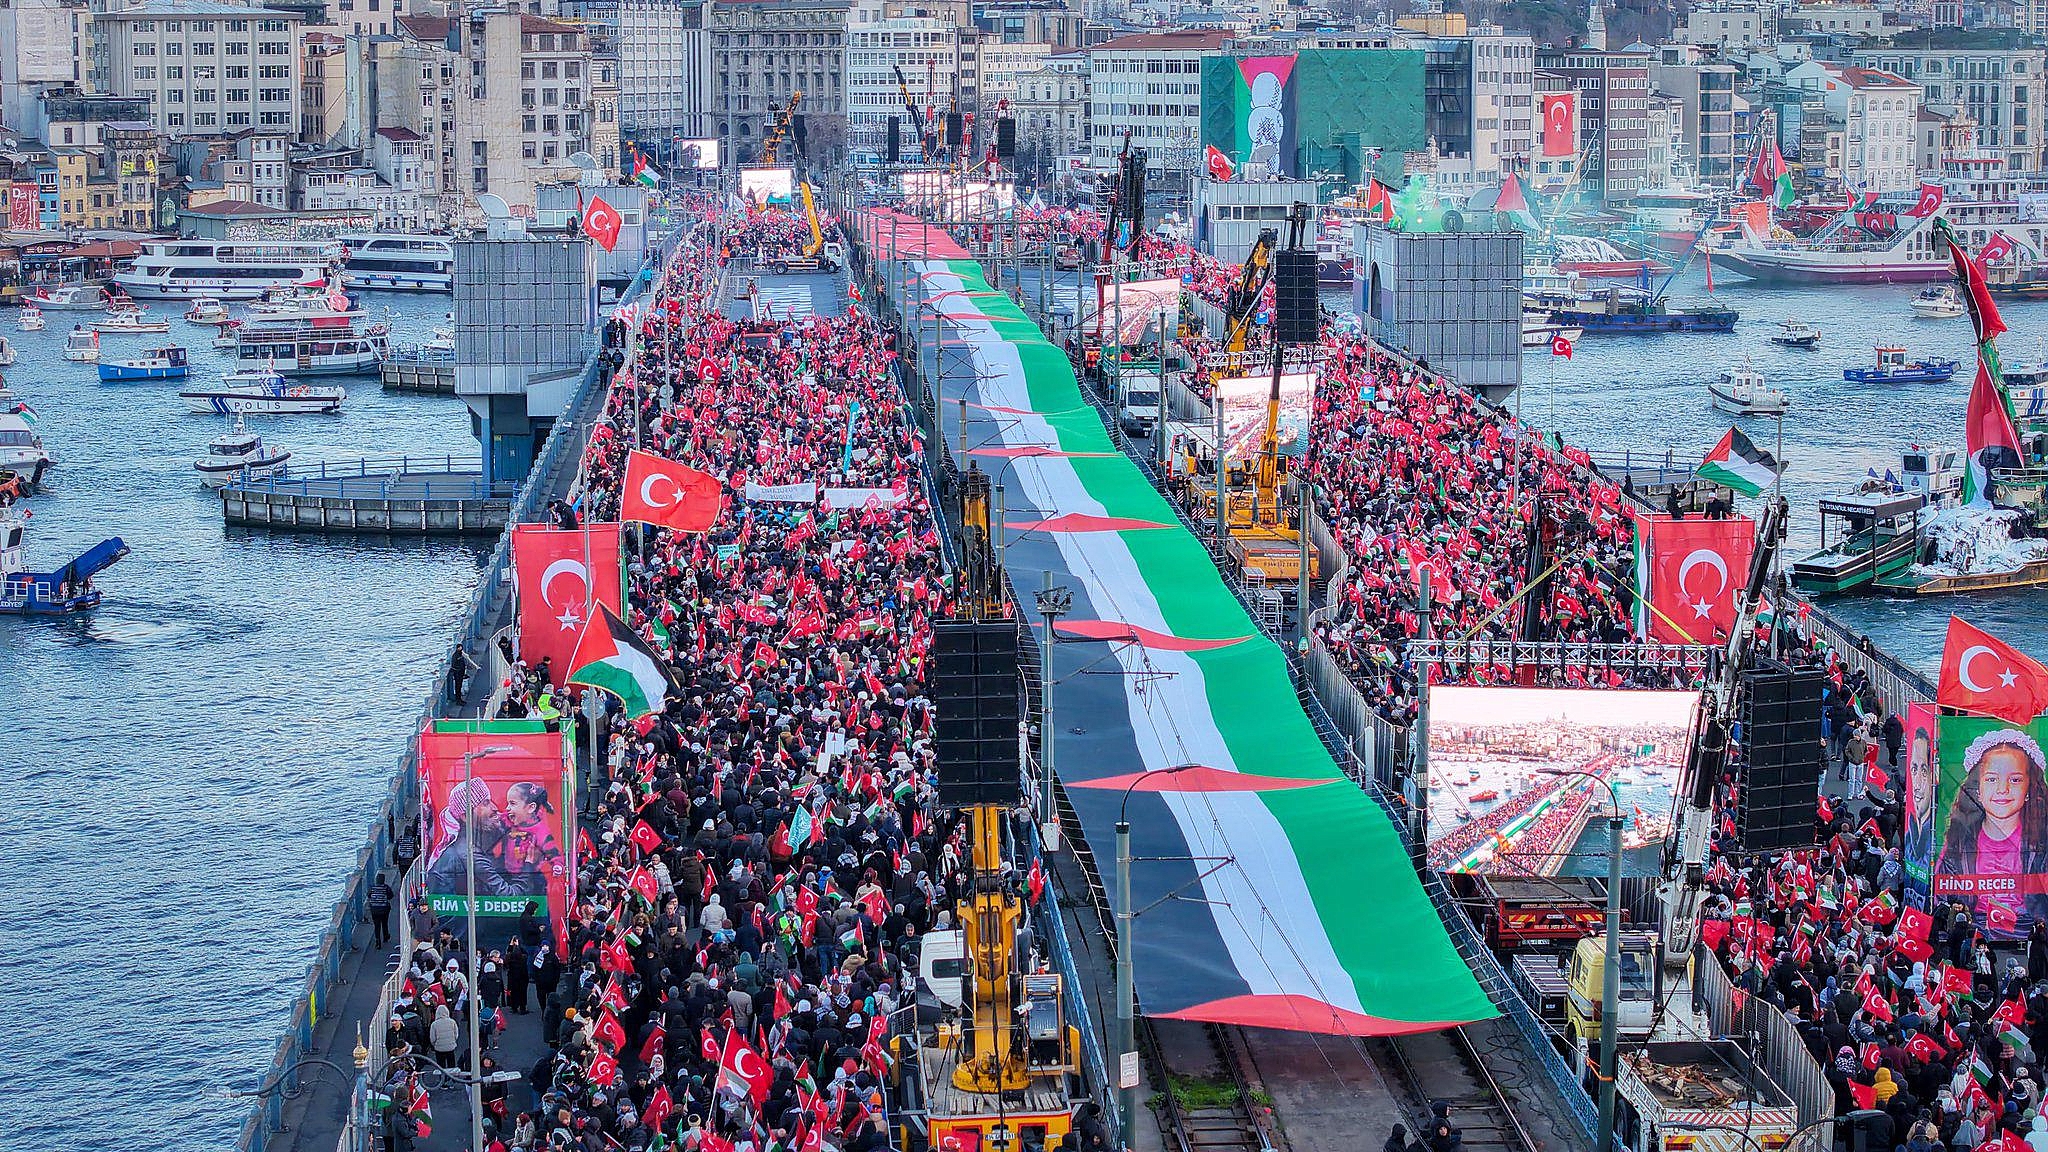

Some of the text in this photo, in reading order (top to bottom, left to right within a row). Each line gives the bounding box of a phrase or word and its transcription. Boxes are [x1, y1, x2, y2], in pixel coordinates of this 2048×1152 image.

[1939, 876, 2016, 891] HİND RECEB
[433, 896, 459, 911] RİM
[484, 897, 530, 913] DEDES
